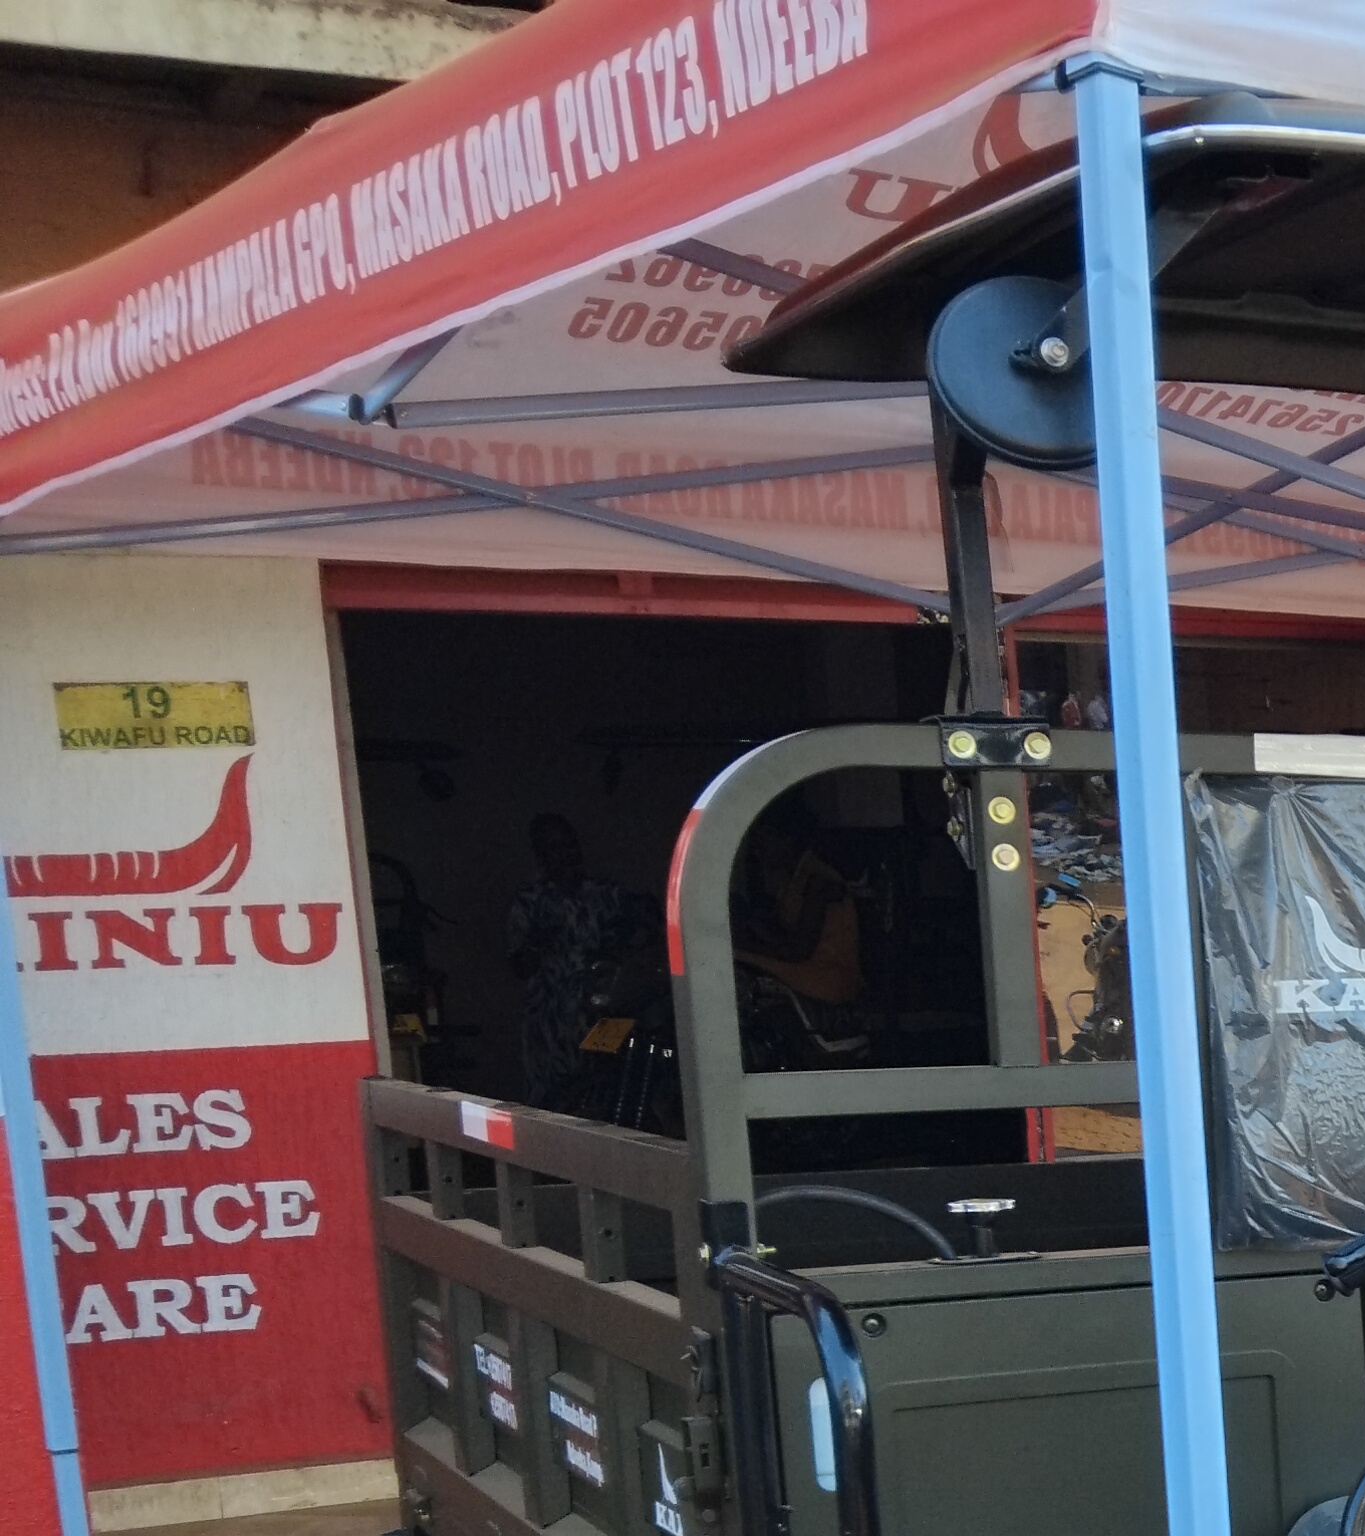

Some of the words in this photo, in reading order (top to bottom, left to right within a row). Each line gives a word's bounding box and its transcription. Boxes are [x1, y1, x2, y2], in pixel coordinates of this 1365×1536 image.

[48, 318, 124, 411] P.O.Box
[116, 270, 193, 384] 168991
[190, 218, 300, 350] KAMPALA
[291, 193, 356, 307] GPO,
[349, 136, 470, 277] MASAKA
[464, 95, 563, 232] ROAD,
[555, 50, 640, 188] PLOT
[636, 16, 720, 152] 123,
[713, 0, 870, 118] NDEEBA
[60, 727, 166, 750] KIWAFU
[173, 724, 254, 748] ROAD
[122, 686, 172, 720] 19
[17, 902, 343, 973] INIU
[34, 1088, 252, 1160] ALES
[48, 1179, 322, 1256] RVICE
[66, 1273, 262, 1345] ARE
